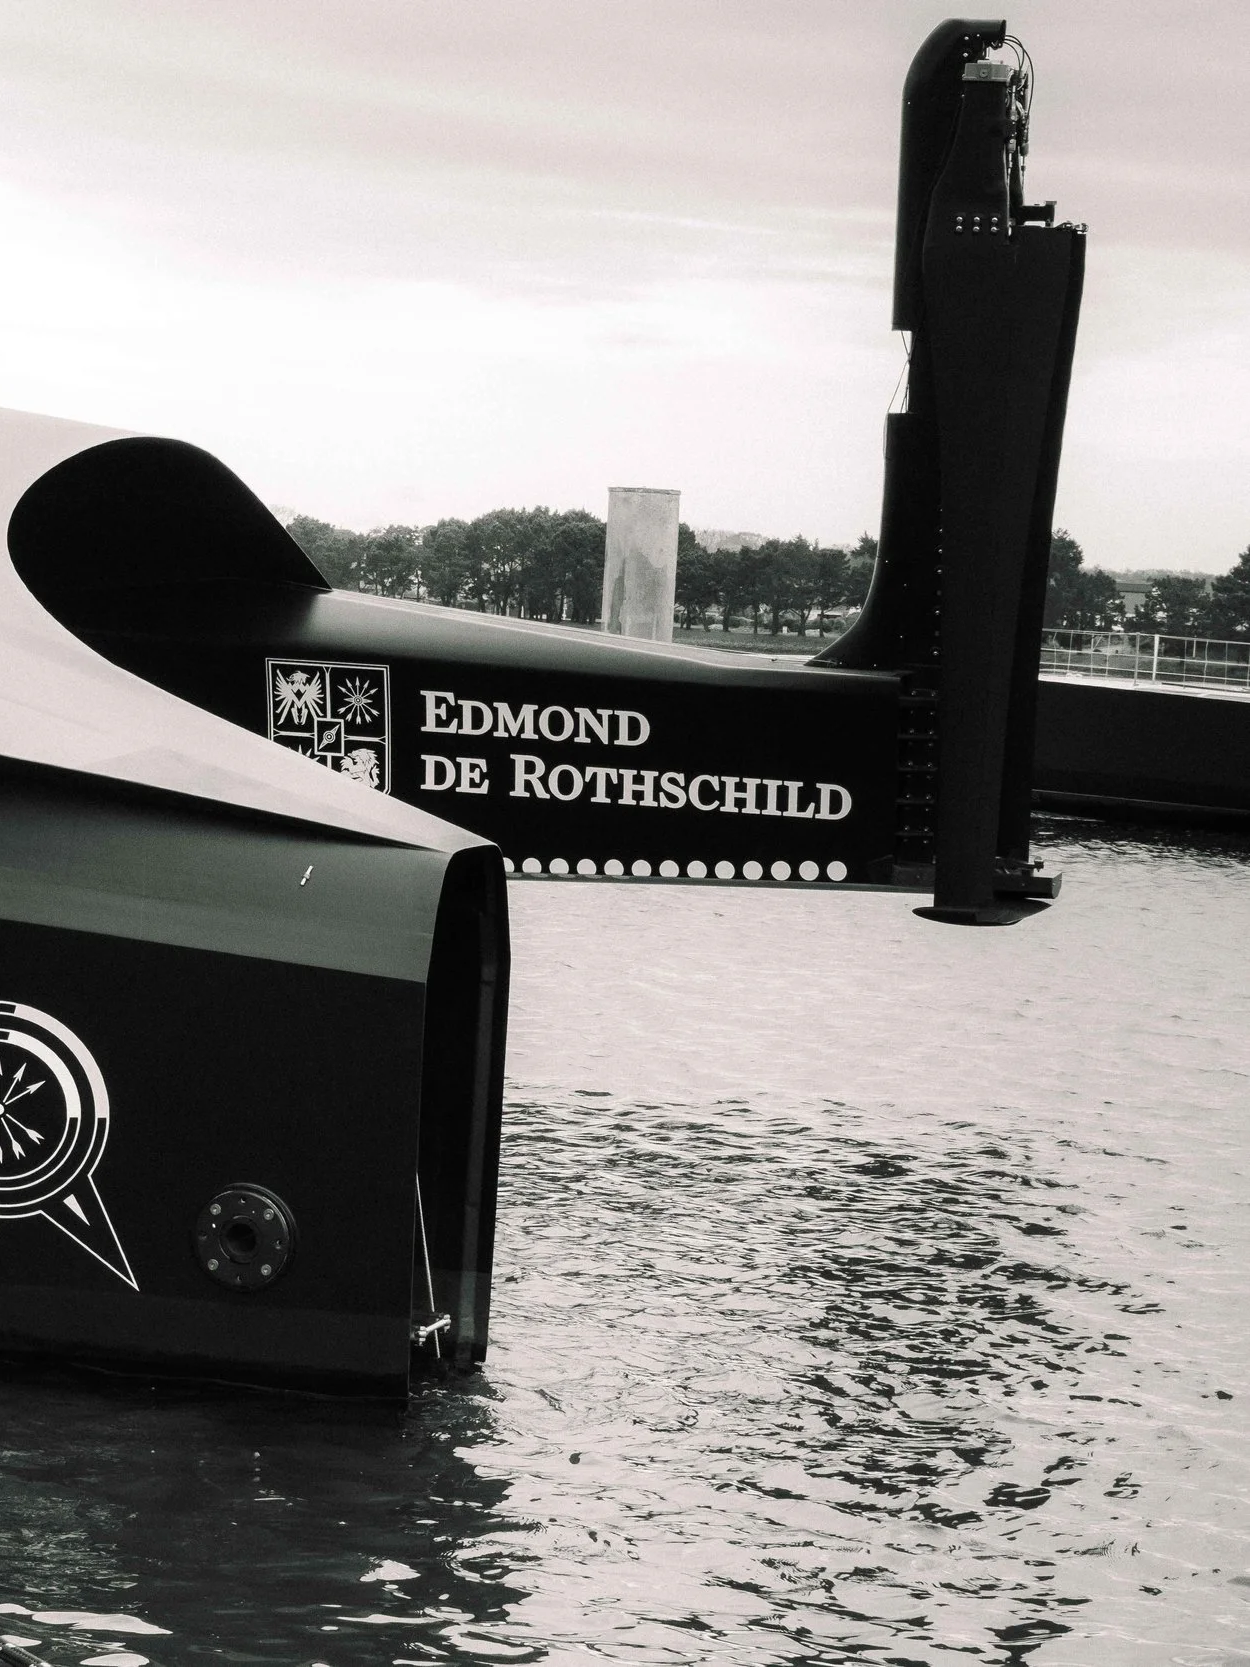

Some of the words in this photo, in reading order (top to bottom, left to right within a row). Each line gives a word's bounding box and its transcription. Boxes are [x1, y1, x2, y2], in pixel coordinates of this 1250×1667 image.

[419, 689, 651, 747] EDMOND
[420, 754, 490, 795] DE
[509, 753, 852, 821] ROTHSCHILD
